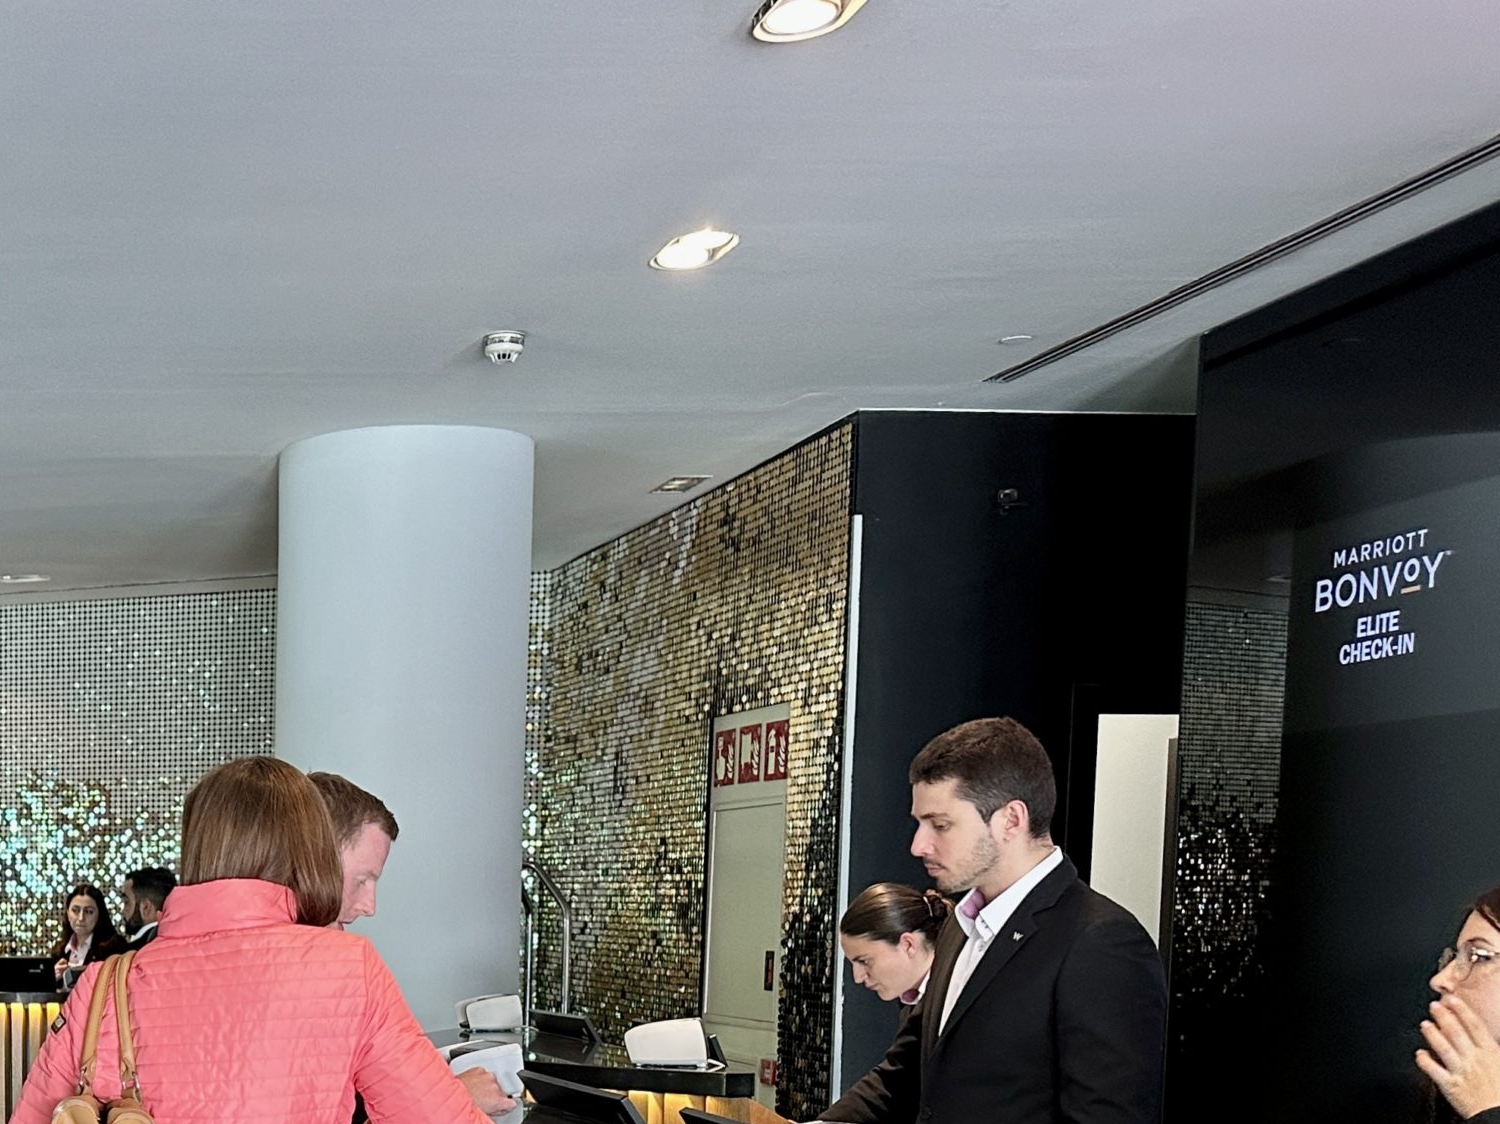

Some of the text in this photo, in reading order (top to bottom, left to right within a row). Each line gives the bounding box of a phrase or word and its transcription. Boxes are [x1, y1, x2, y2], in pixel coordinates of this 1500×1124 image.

[1333, 528, 1428, 568] MARRIOTT
[1315, 551, 1445, 613] BONVOY
[1356, 610, 1400, 638] ELITE
[1339, 632, 1415, 665] CHECK-IN
